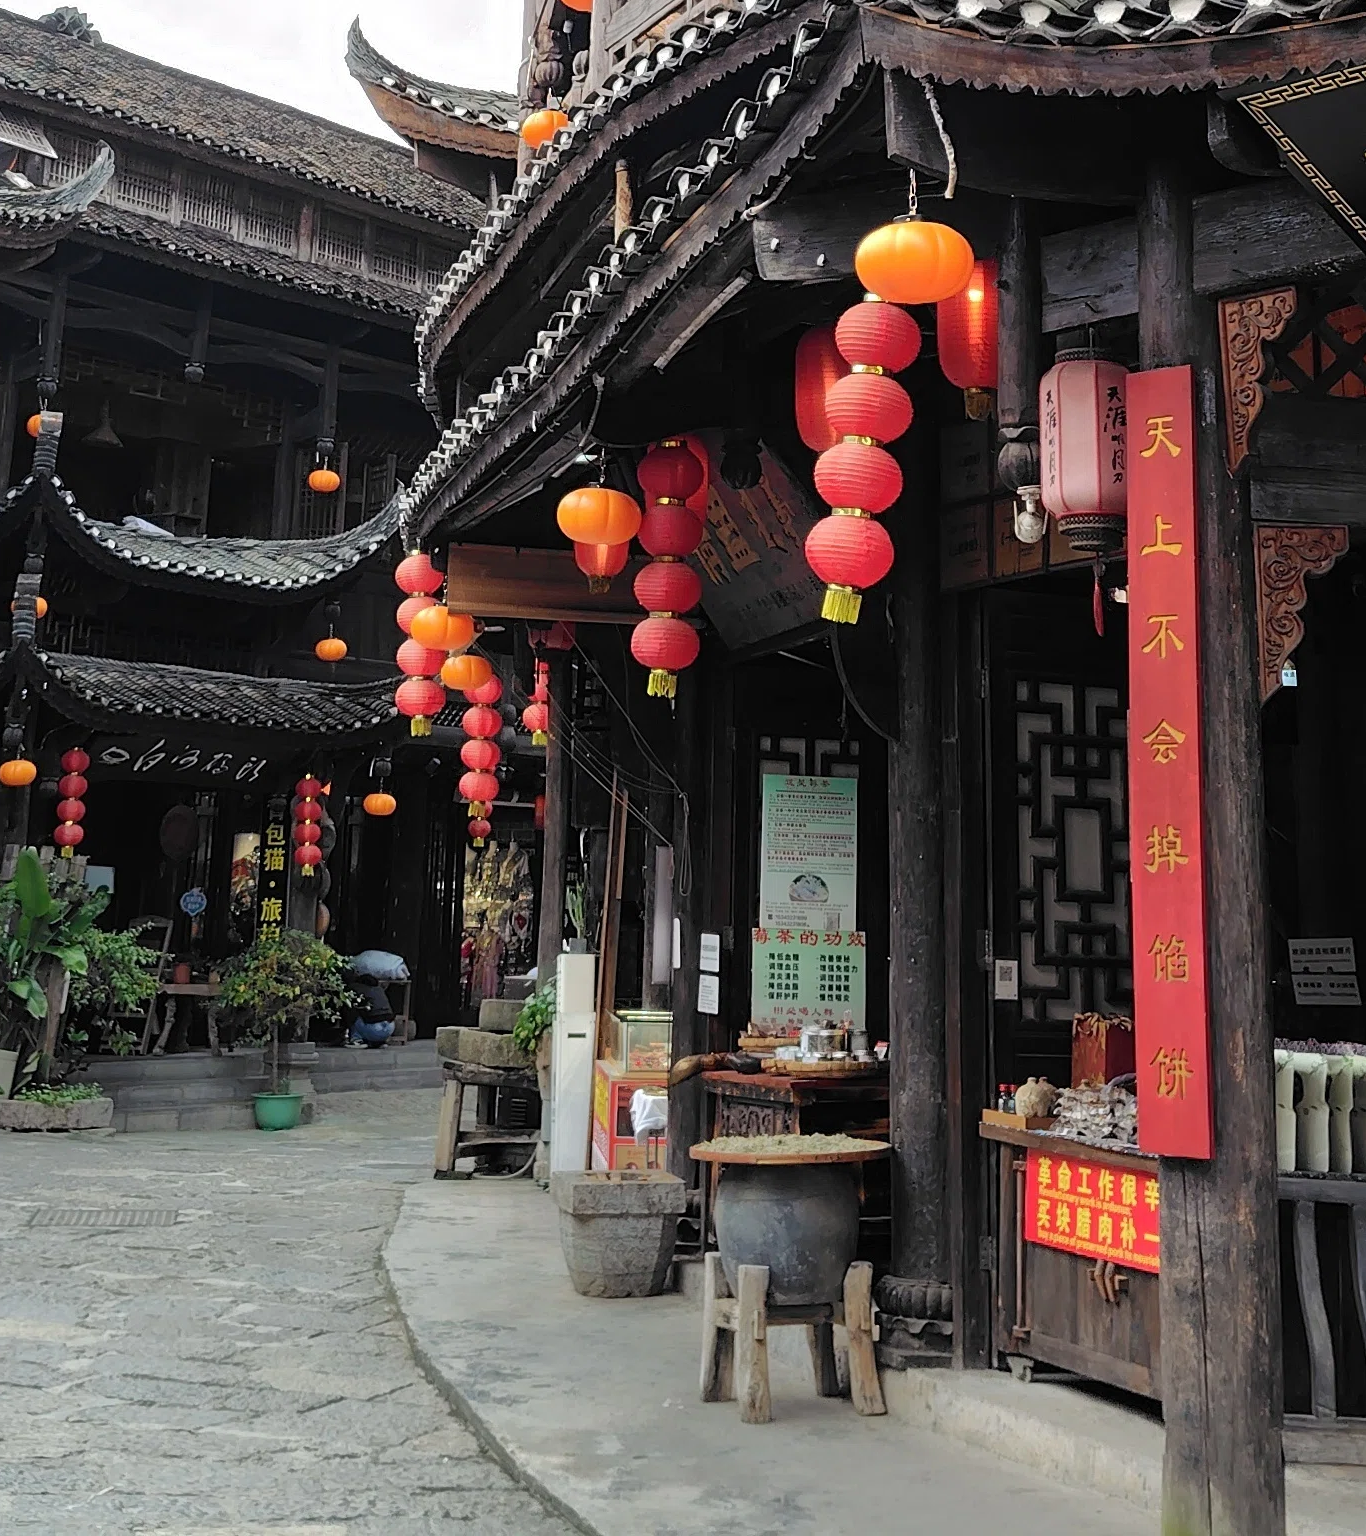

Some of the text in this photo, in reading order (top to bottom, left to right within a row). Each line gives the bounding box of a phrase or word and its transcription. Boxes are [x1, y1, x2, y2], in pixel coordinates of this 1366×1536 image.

[1140, 415, 1194, 1100] 天上不会掉馅饼
[1037, 1155, 1159, 1212] 革命工作很辛
[1037, 1198, 1160, 1250] 买块腊肉补一
